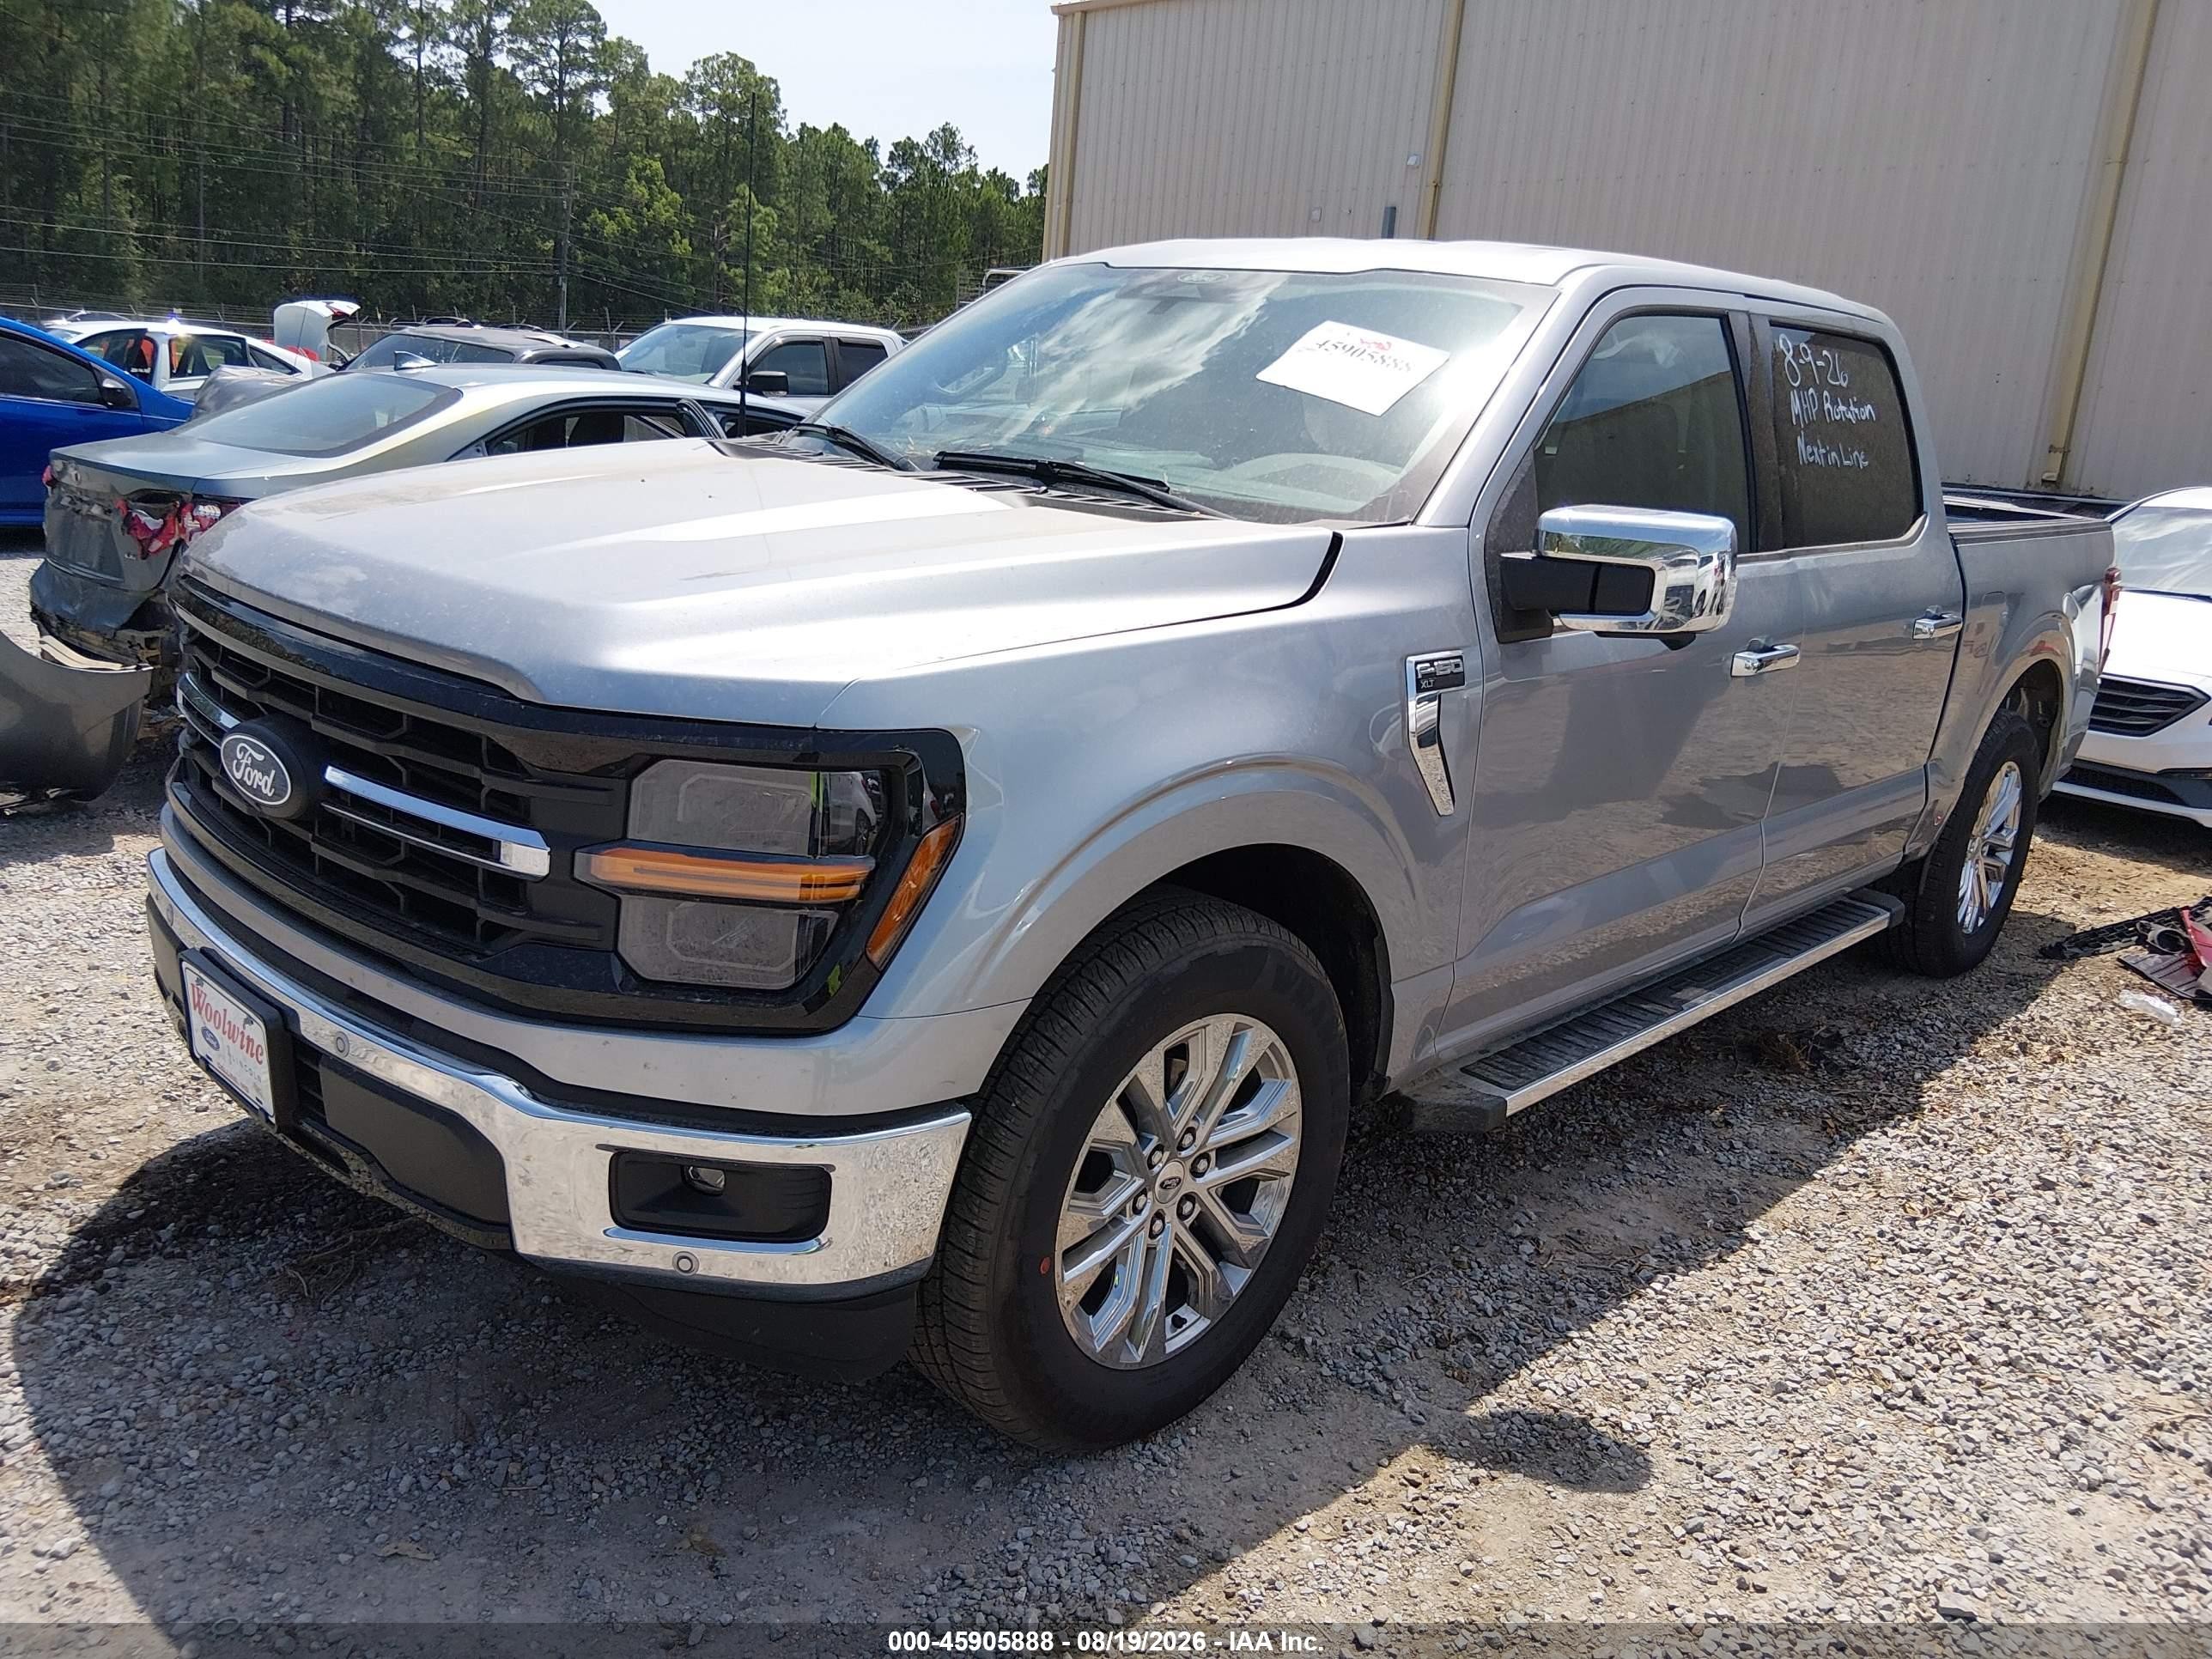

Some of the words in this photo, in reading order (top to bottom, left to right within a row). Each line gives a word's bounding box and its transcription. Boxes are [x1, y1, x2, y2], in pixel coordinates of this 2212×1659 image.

[1779, 333, 1849, 388] 8-9-26
[1822, 390, 1876, 424] Rotation
[1796, 430, 1826, 467] Next
[1419, 678, 1435, 690] XLT
[233, 743, 276, 797] Ford
[191, 983, 264, 1066] Woolwine
